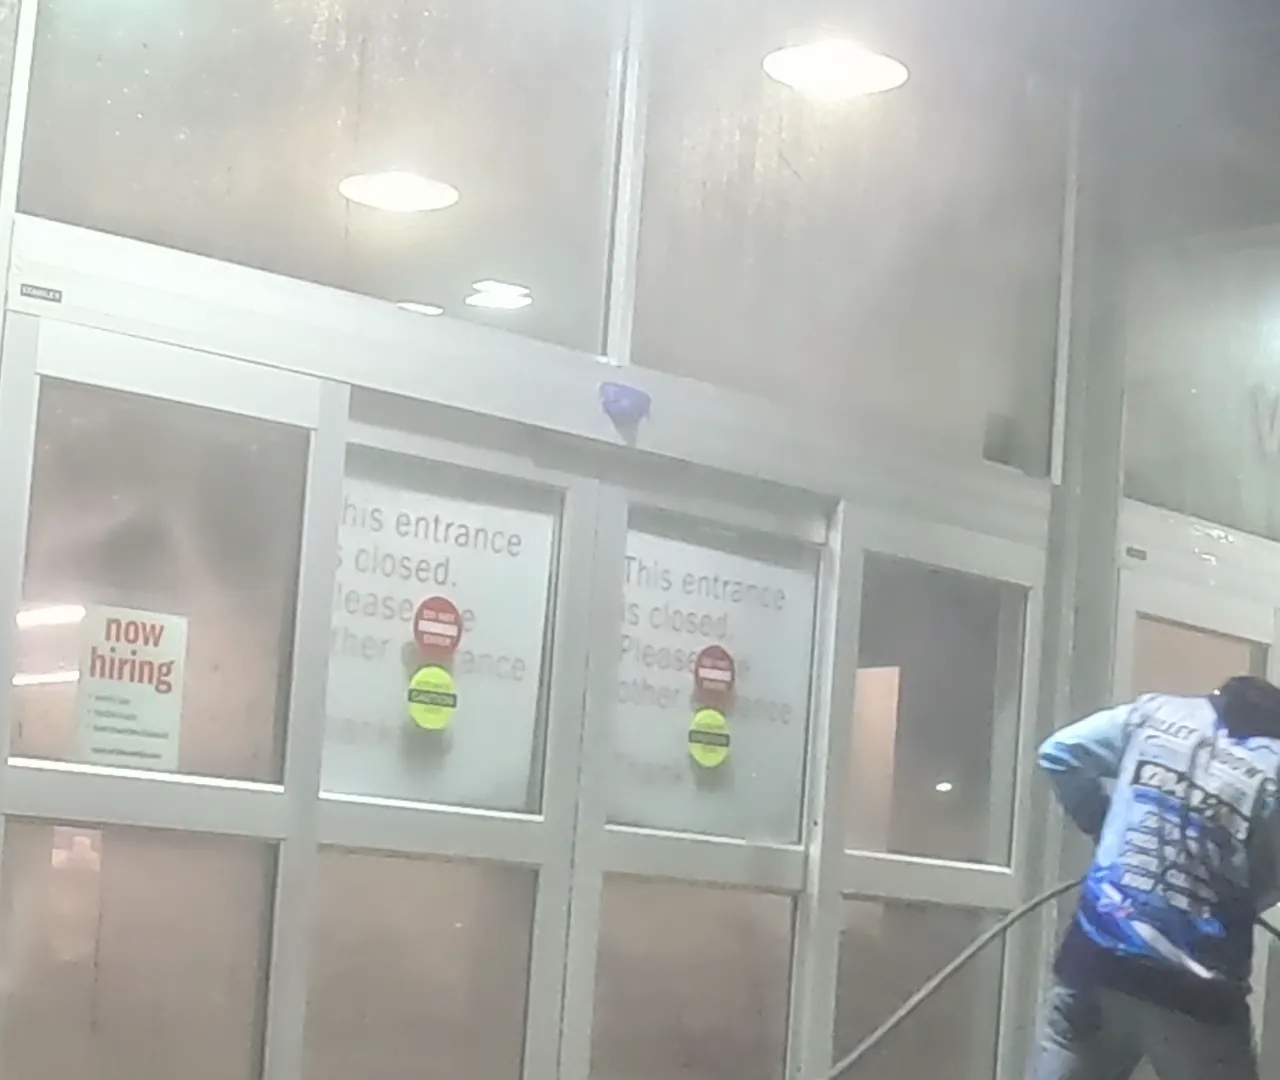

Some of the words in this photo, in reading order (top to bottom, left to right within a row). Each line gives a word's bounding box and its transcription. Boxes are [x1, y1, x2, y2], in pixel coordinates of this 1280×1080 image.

[341, 496, 384, 532] his
[395, 511, 522, 557] entrance
[354, 547, 458, 588] closed.
[623, 554, 673, 592] This
[682, 572, 786, 612] entrance
[105, 618, 165, 647] now
[89, 646, 176, 694] hiring
